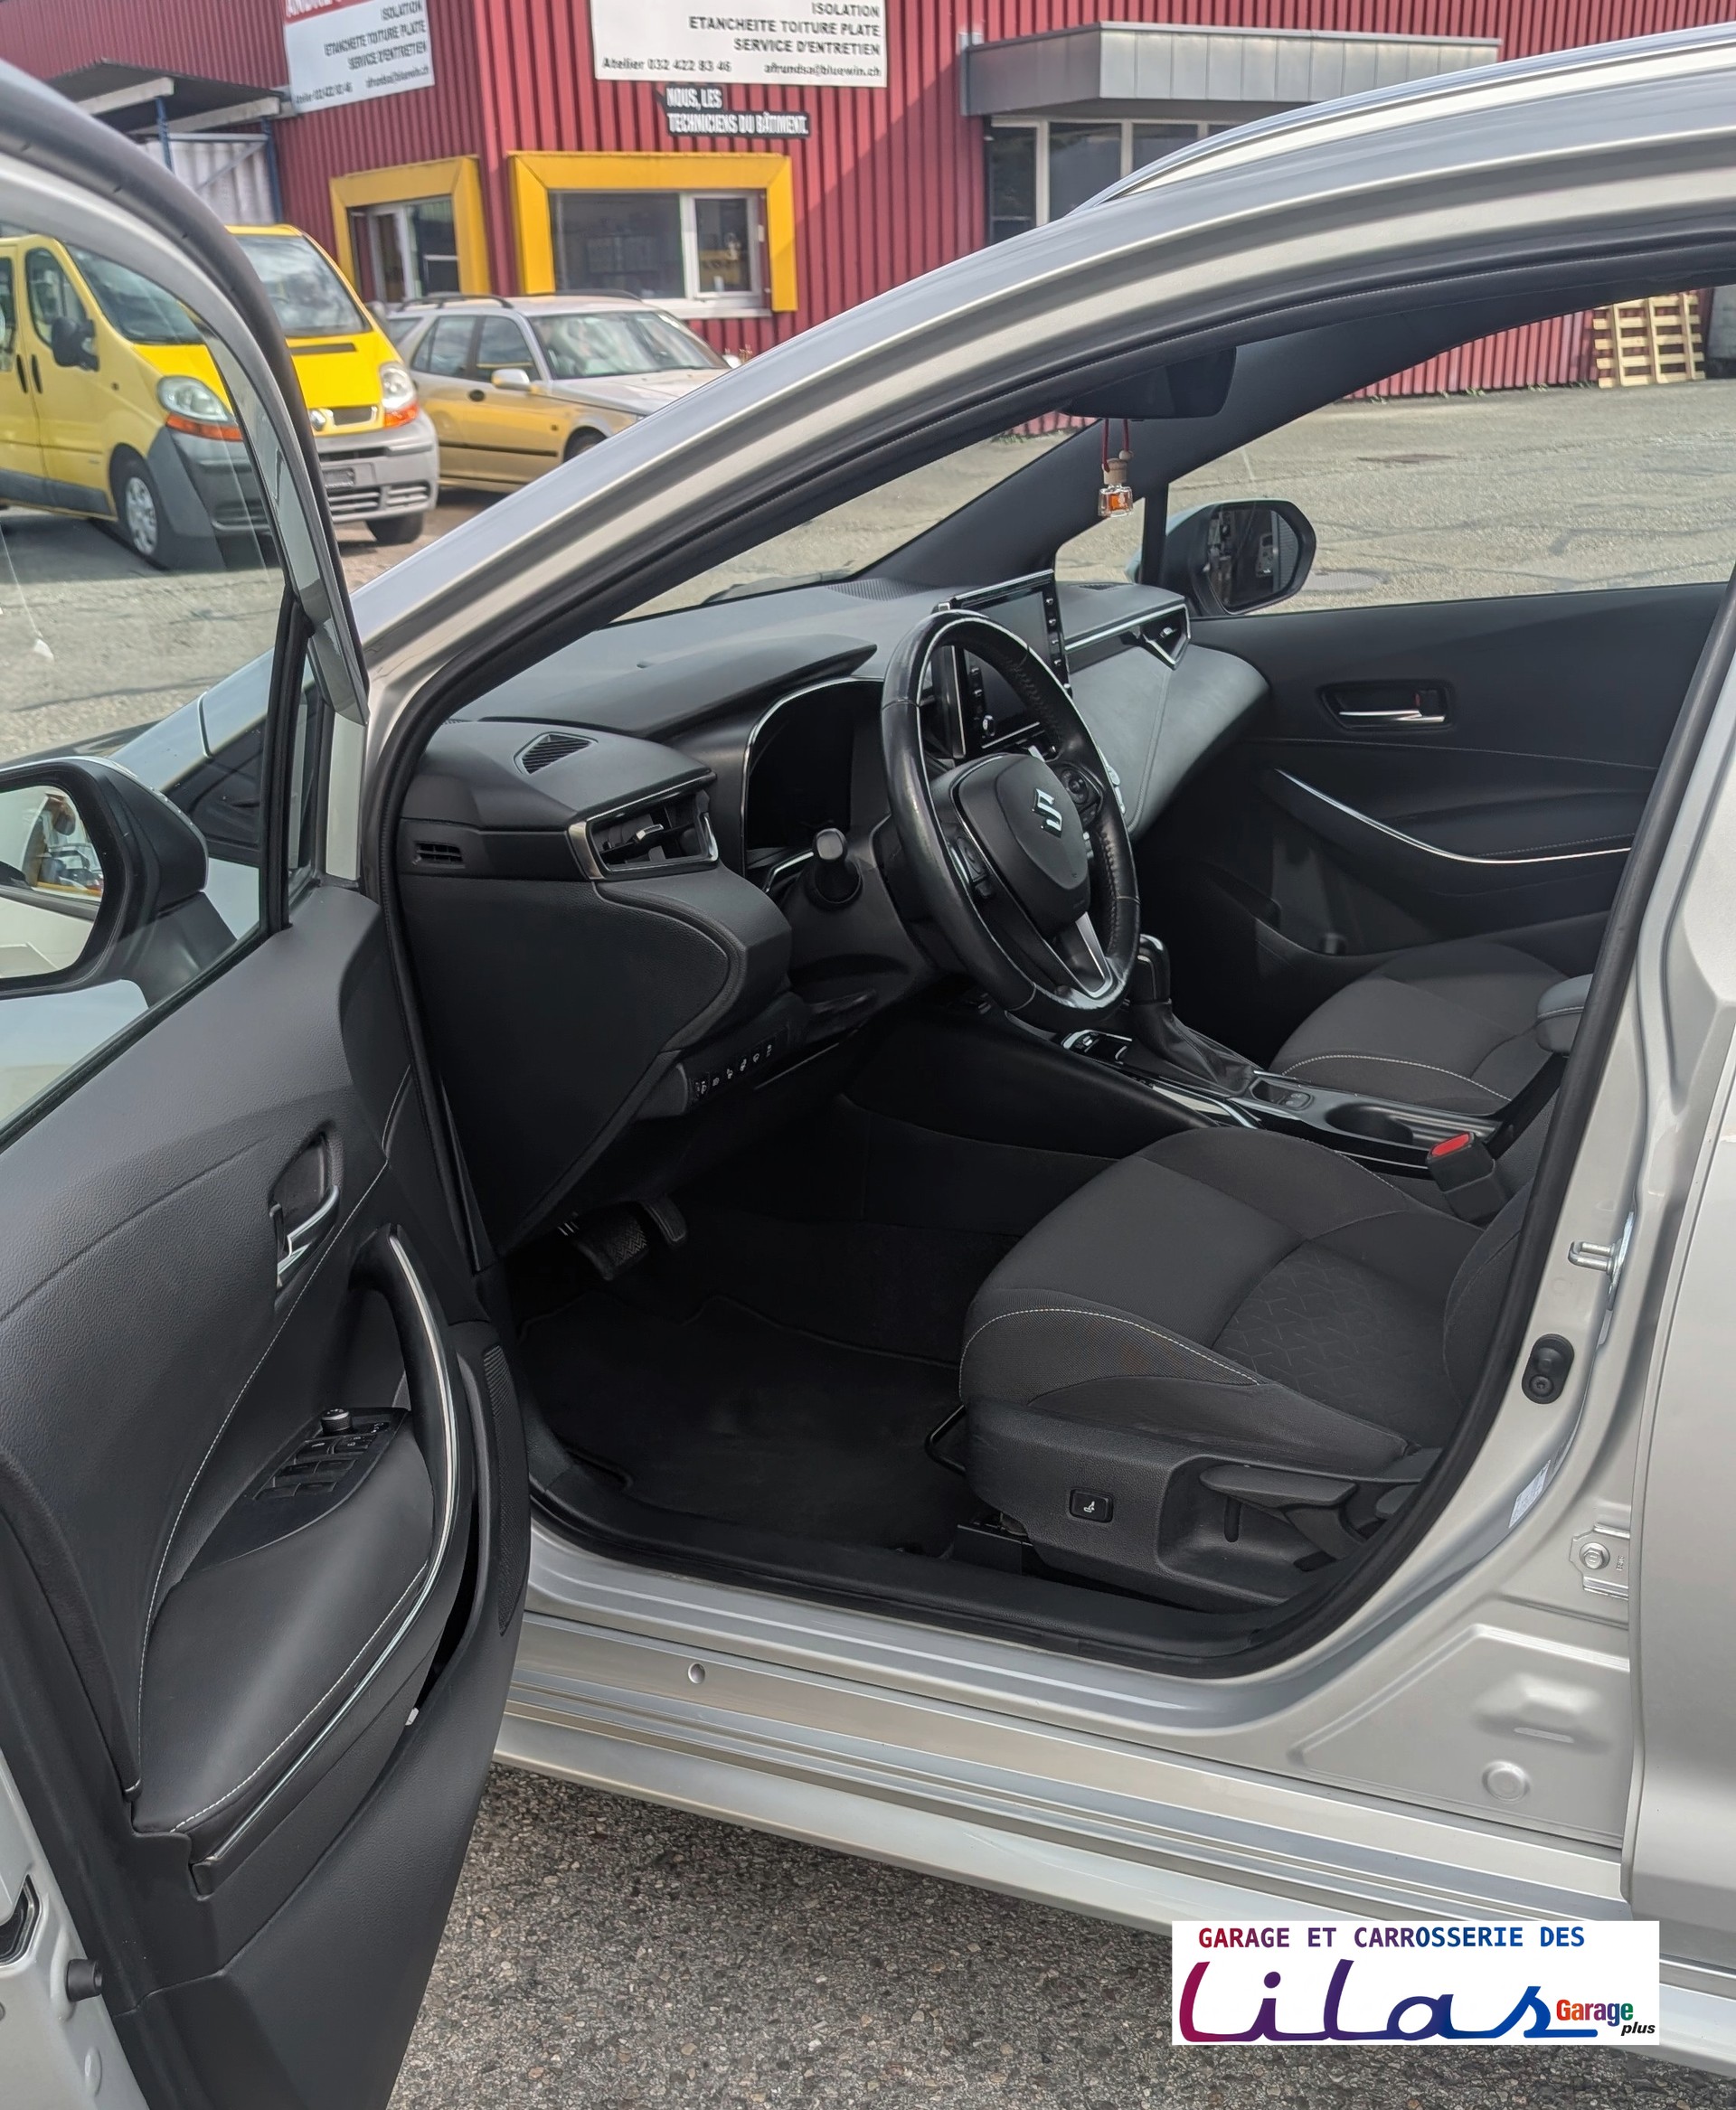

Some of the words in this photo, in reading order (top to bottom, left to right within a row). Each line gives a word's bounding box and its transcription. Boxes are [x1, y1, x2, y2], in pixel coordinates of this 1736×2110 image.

[812, 2, 880, 18] ISOLATION
[689, 15, 778, 33] ETANCHEITE
[780, 20, 837, 35] TOITURE
[840, 24, 881, 37] PLATE
[733, 37, 793, 53] SERVICE
[797, 41, 881, 56] D'ENTRETIEN
[602, 57, 645, 70] Atelier
[647, 58, 669, 71] 032
[673, 59, 695, 71] 422
[666, 88, 701, 110] NOUS,
[702, 89, 722, 108] LES
[666, 113, 738, 134] TECHNICIENS
[739, 115, 755, 134] DU
